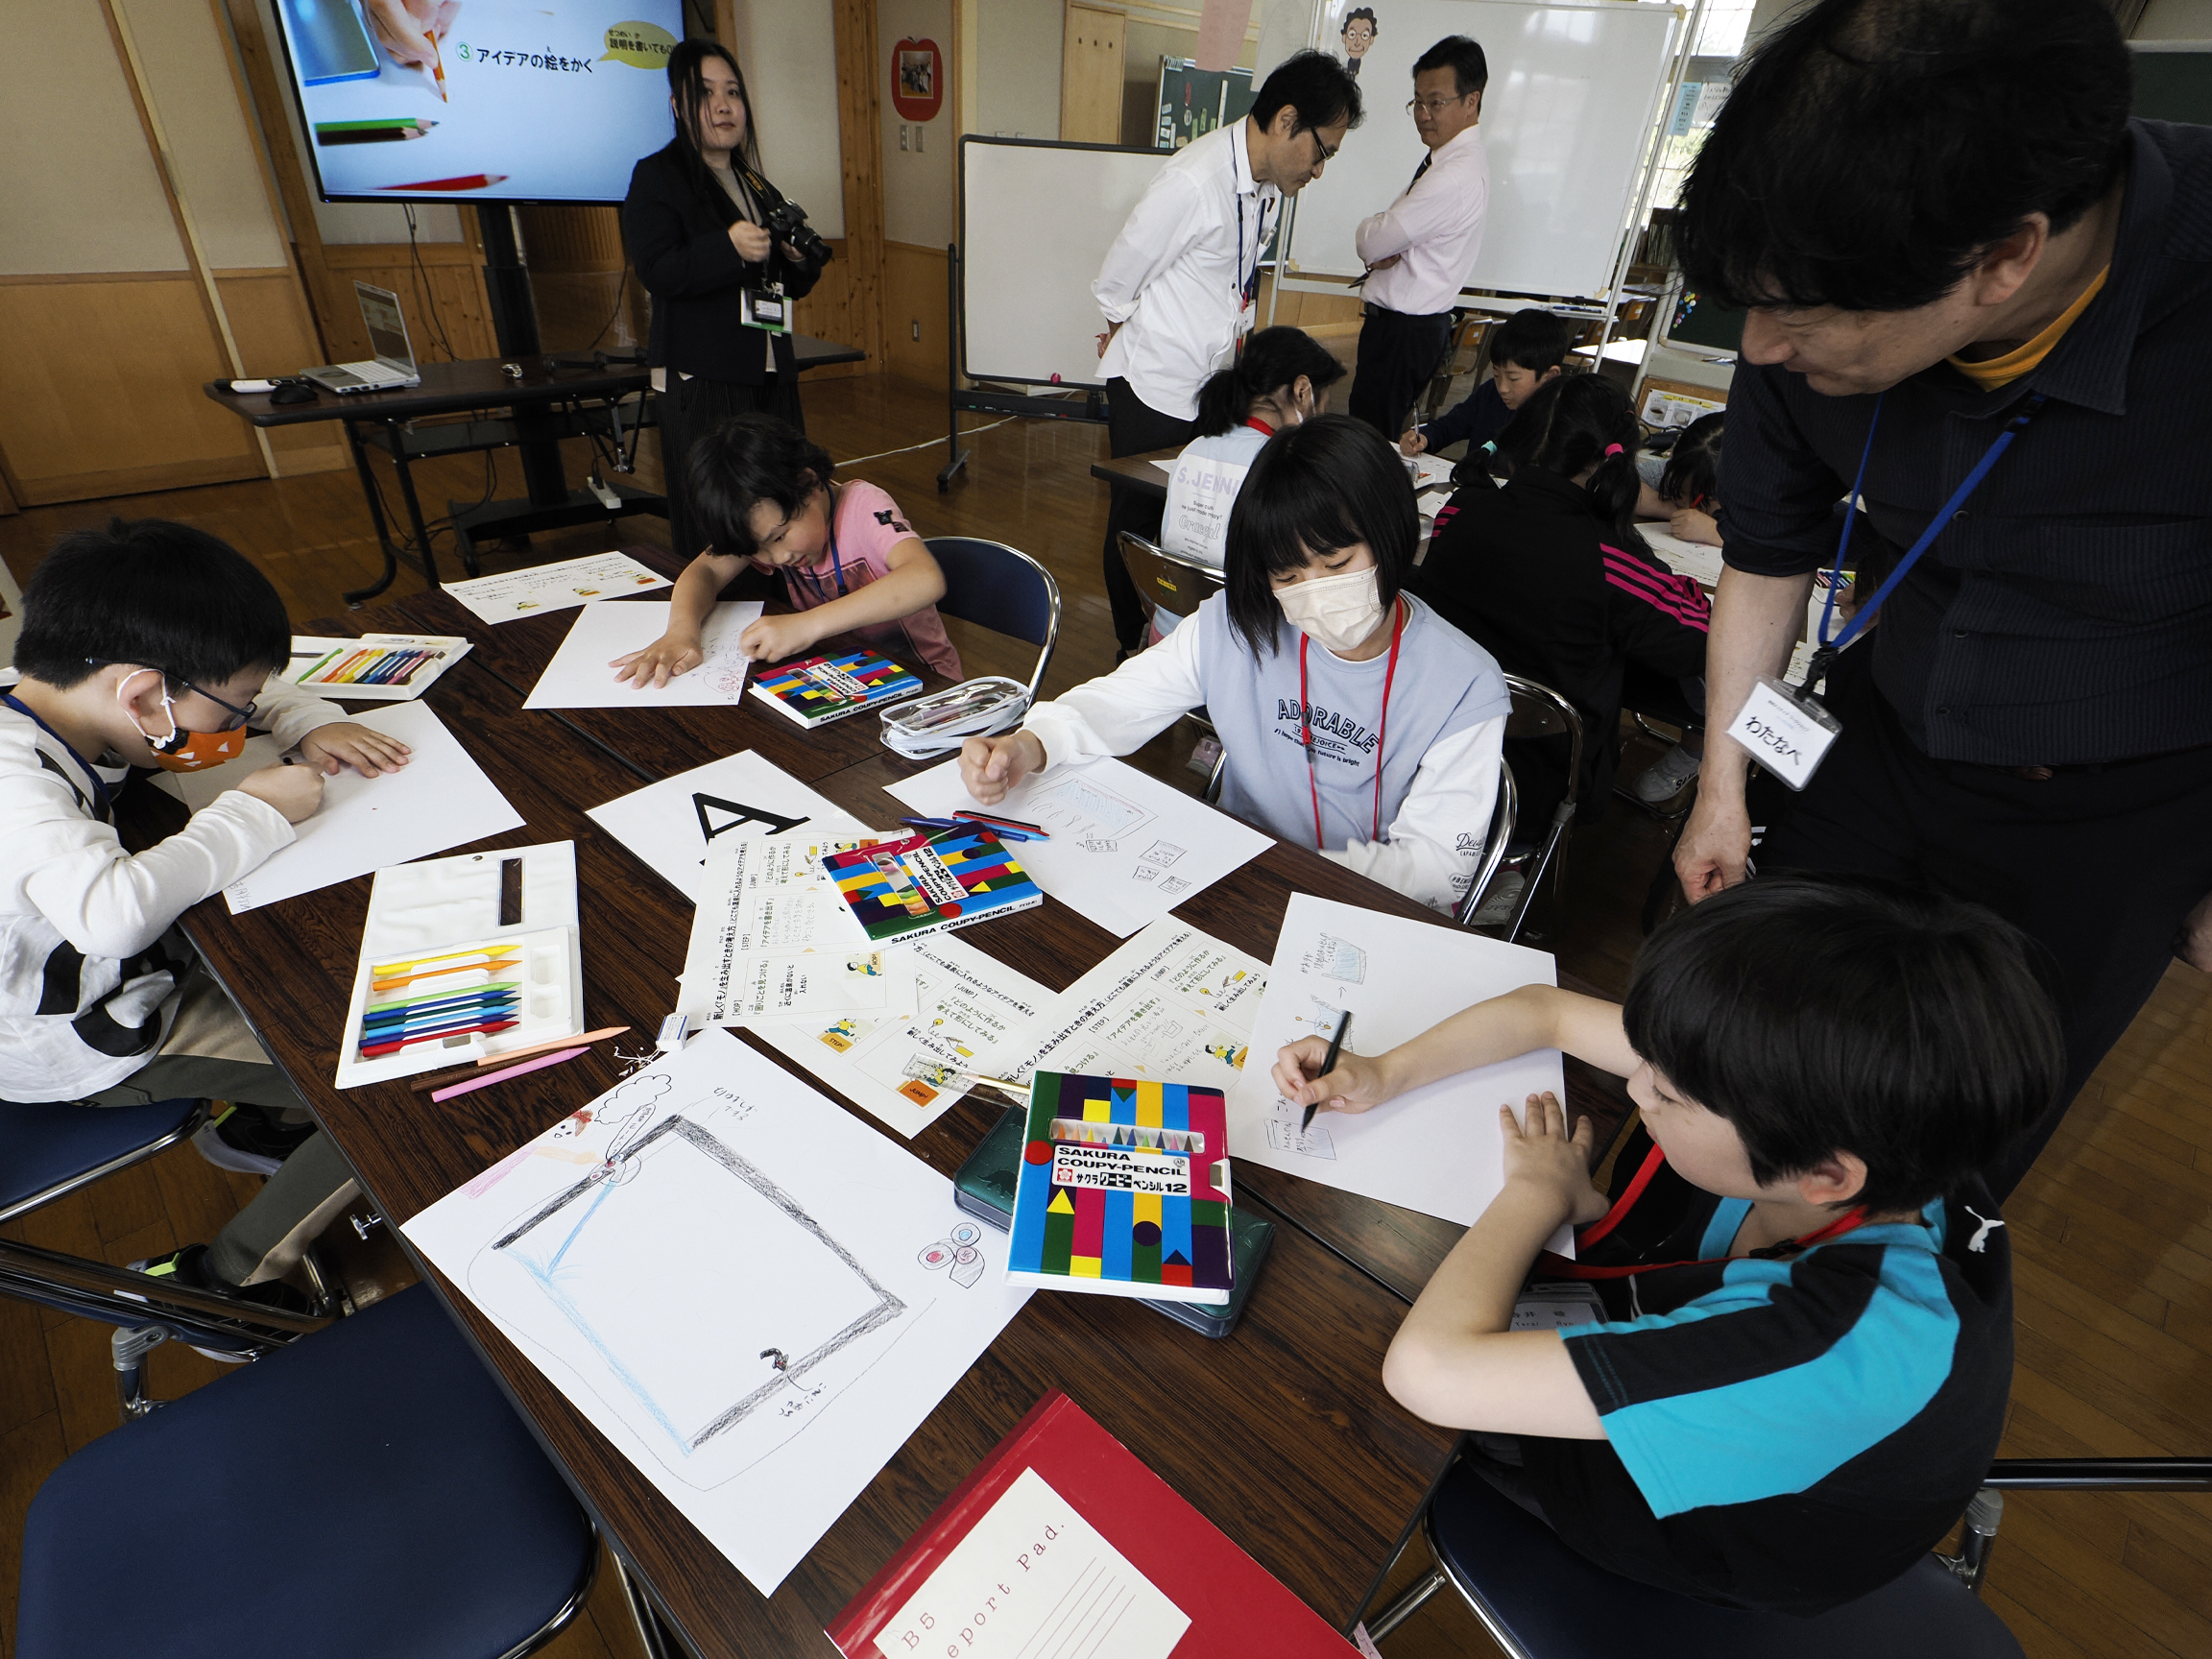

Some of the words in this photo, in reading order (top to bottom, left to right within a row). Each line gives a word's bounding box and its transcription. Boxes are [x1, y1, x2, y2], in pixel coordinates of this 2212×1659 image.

[610, 37, 676, 55] 説明を書いてもO
[476, 48, 593, 73] アイデアの絵をかく
[820, 709, 852, 723] SAKURA
[1317, 750, 1336, 759] future
[1342, 757, 1360, 767] bright
[912, 851, 951, 901] COUPY-PENCIL
[919, 875, 943, 903] SAKURA
[891, 928, 936, 944] SAKURA
[940, 905, 1016, 930] COUPY-PENCIL
[909, 1087, 928, 1100] JUMP!
[1059, 1147, 1130, 1161] SAKURA
[1057, 1158, 1188, 1177] COUPY-PENCIL
[1016, 1524, 1065, 1573] Pad.
[902, 1612, 935, 1651] B5
